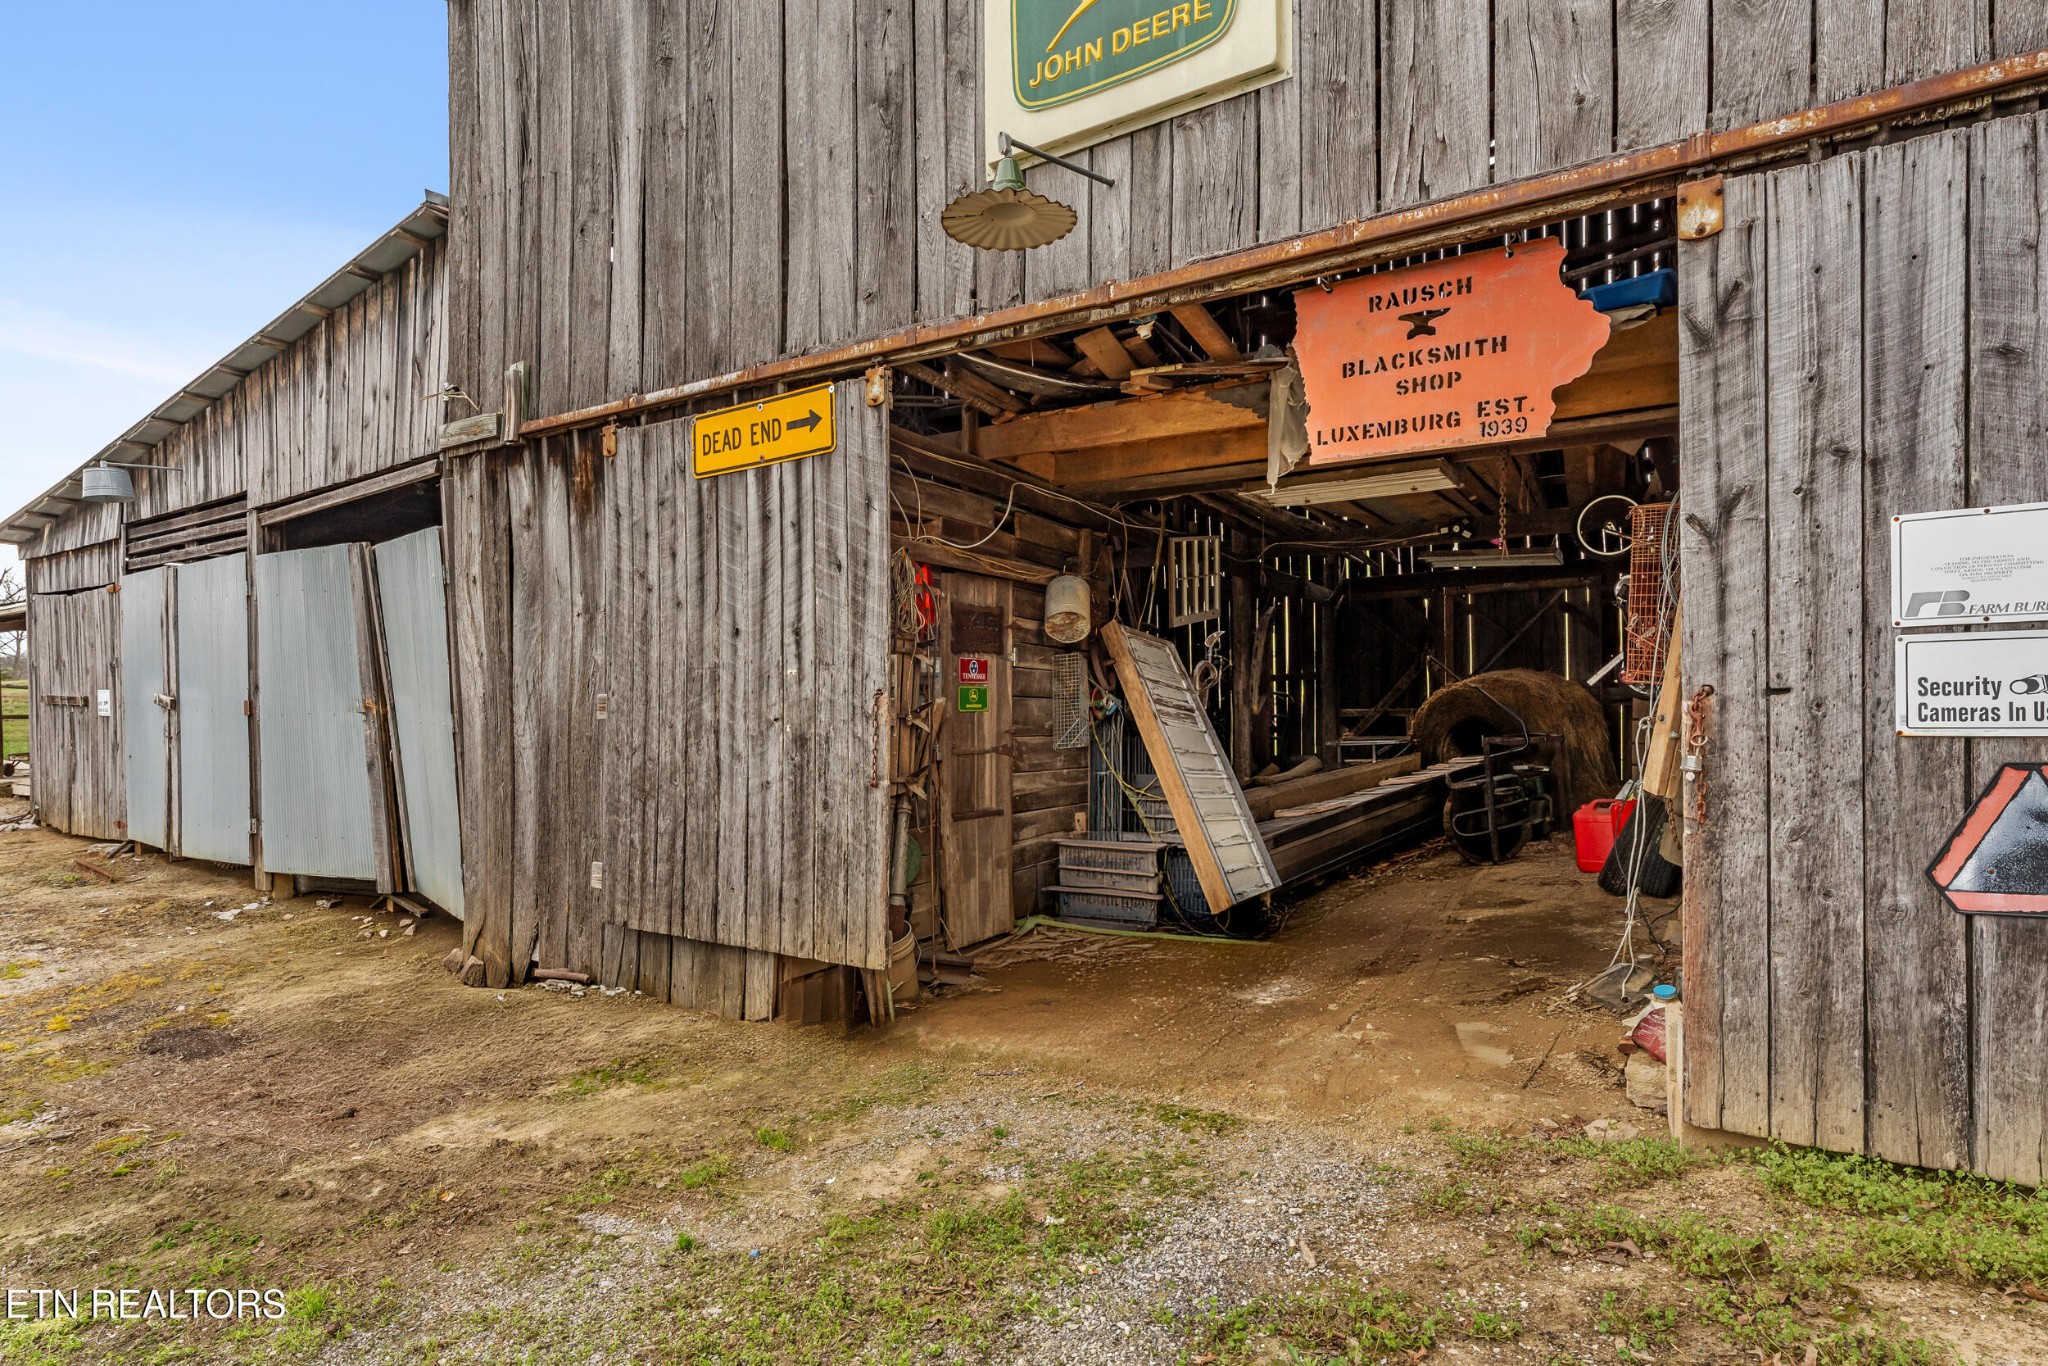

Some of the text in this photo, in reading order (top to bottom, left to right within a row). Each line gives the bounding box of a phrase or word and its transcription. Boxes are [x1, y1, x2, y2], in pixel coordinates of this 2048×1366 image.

[1029, 0, 1213, 88] JOHN DEERE
[1368, 276, 1473, 313] RAUSCH
[1342, 335, 1508, 379] BLACKSMITH
[1396, 371, 1462, 396] SHOP
[1316, 396, 1535, 446] LUXEMBURG EST.
[1479, 416, 1528, 438] 1939
[702, 418, 782, 456] DEAD END
[1968, 602, 2010, 615] FARM
[2013, 600, 2048, 613] BUR
[1917, 675, 2002, 700] Security
[1917, 702, 2001, 722] Cameras
[2008, 701, 2027, 722] In
[2033, 701, 2048, 722] U
